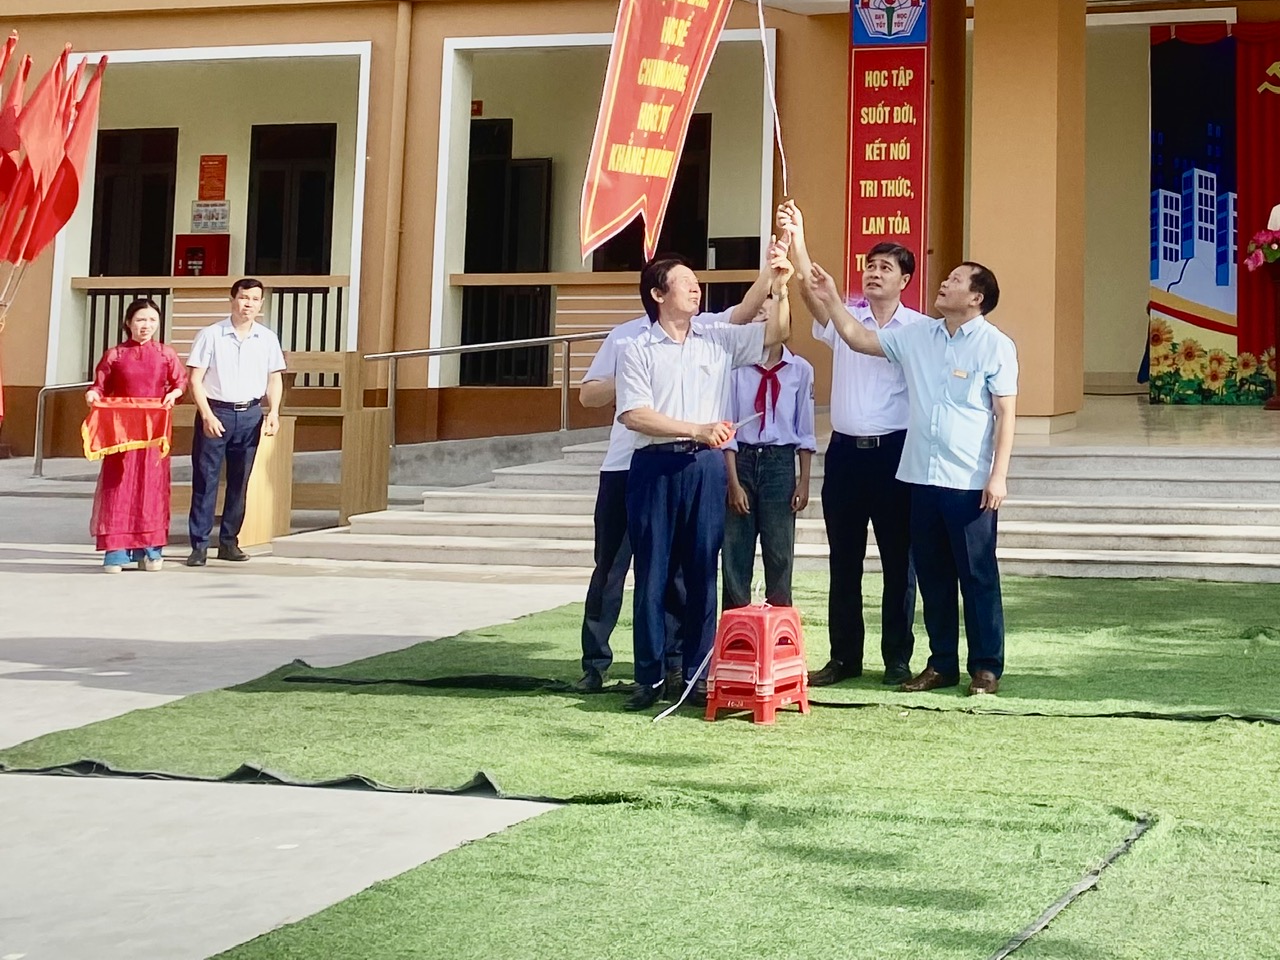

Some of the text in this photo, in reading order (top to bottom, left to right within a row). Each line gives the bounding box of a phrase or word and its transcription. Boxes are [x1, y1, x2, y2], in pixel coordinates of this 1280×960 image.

[865, 66, 914, 91] HỌC TẬP
[860, 100, 917, 126] SUỐT ĐỜI,
[865, 136, 911, 161] KẾT NỐI
[859, 176, 914, 200] TRI THỨC,
[862, 211, 911, 235] LAN TỎA
